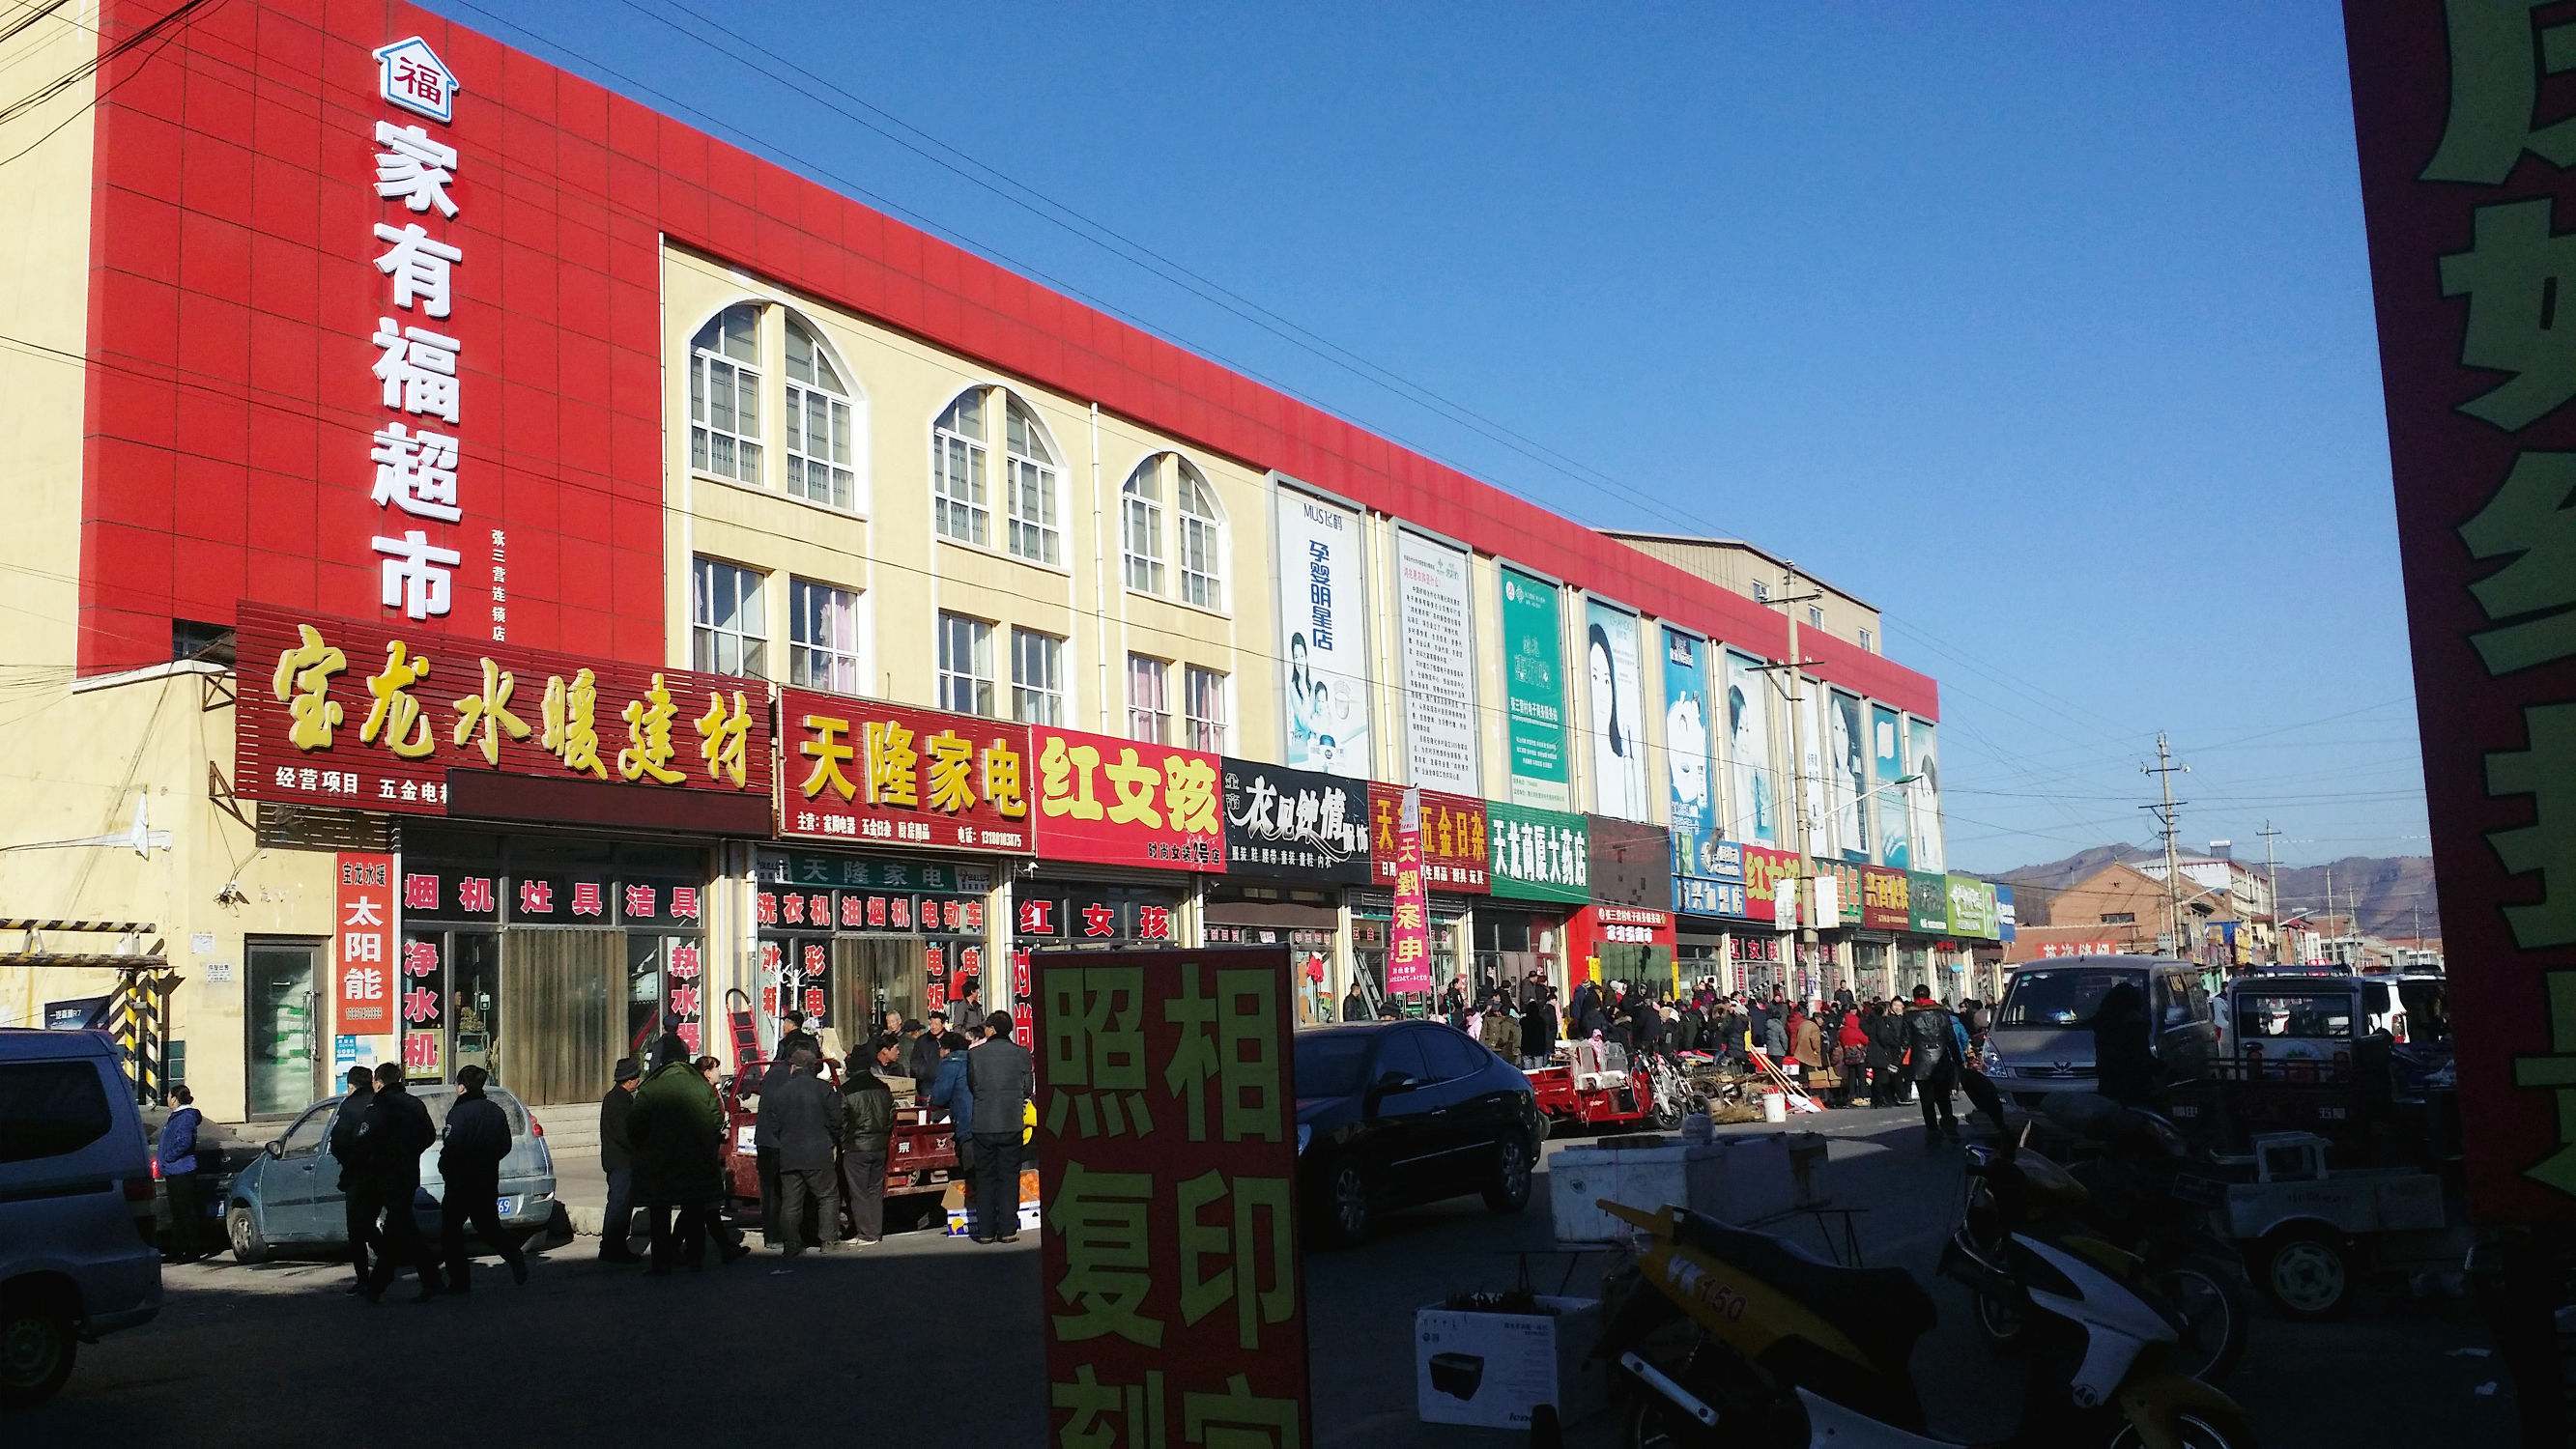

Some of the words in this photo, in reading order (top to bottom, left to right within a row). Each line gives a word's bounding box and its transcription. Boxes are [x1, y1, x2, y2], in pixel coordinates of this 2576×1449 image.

[394, 55, 442, 107] 福
[371, 121, 462, 619] 家有福超市
[491, 529, 505, 642] 张三营连锁店
[1309, 539, 1332, 651] 孕婴明星店
[272, 624, 753, 789] 宝龙水暖建材
[275, 766, 358, 794] 经营项目
[799, 715, 1026, 819] 天隆家电
[1039, 736, 1220, 836] 红女孩
[342, 862, 386, 887] 宝龙水暖
[803, 858, 944, 888] 天隆家电
[1148, 841, 1220, 865] 时尚女装2号店
[1377, 799, 1485, 862] 天五金日杂
[405, 873, 495, 912] 烟机
[520, 880, 603, 917] 灶具
[625, 883, 701, 920] 洁具
[757, 892, 831, 926] 洗衣机
[842, 895, 910, 927] 油烟机
[921, 898, 983, 929] 电动车
[1019, 899, 1169, 939] 红女孩
[343, 895, 384, 1000] 太阳能
[805, 945, 825, 1017] 彩电
[403, 941, 439, 1068] 净水机
[671, 945, 700, 1055] 热水器
[1043, 963, 1284, 1143] 照相
[1047, 1159, 1297, 1350] 复印
